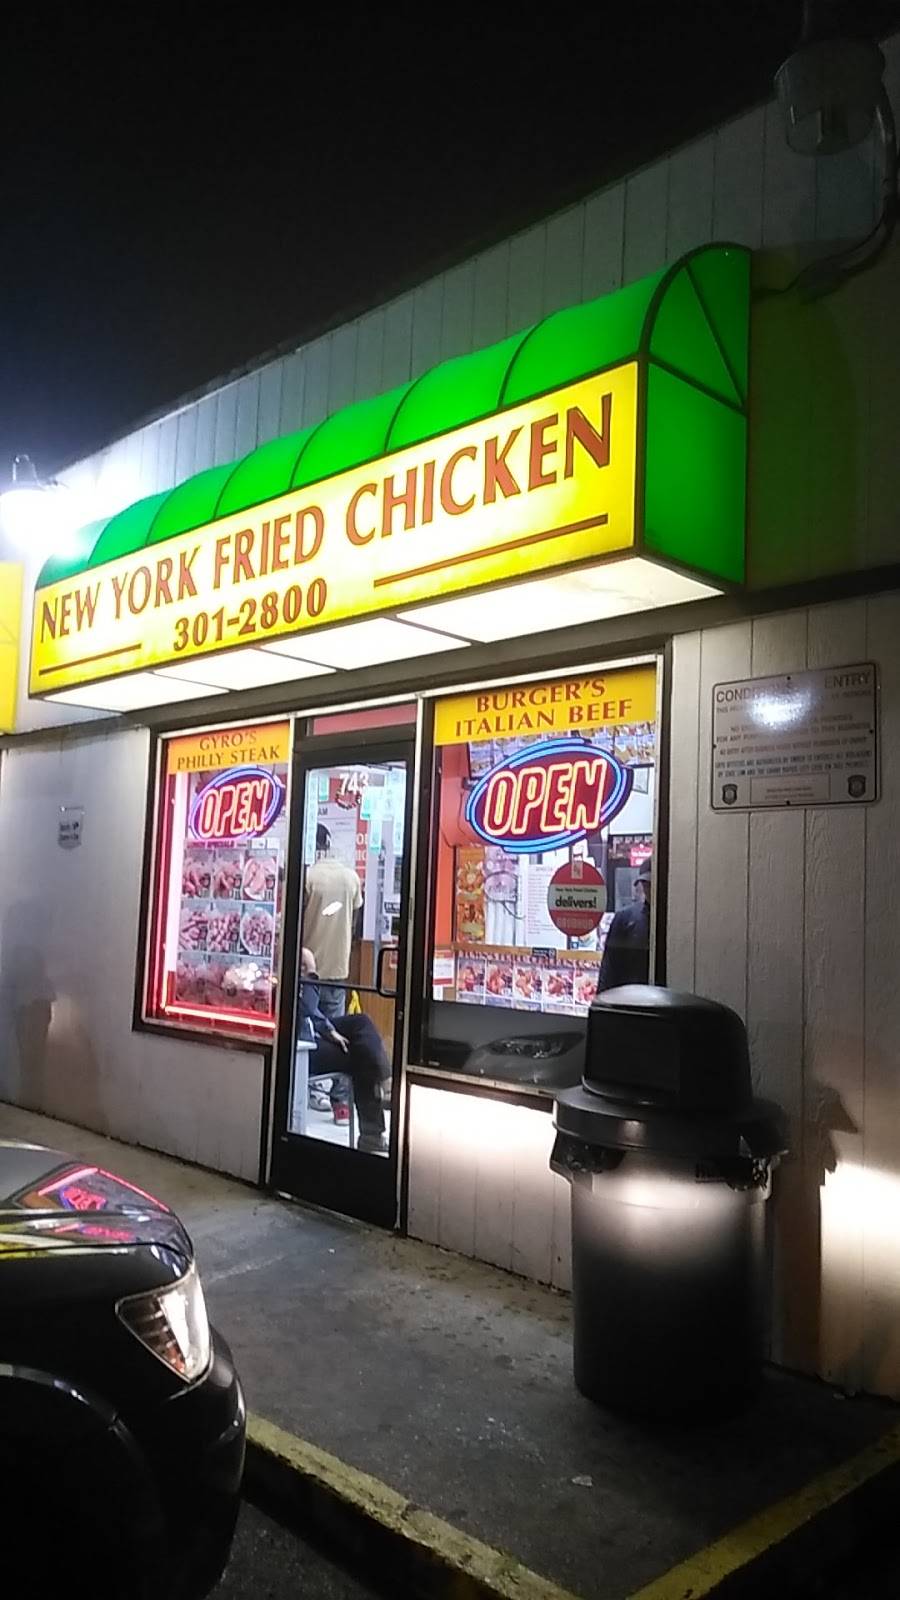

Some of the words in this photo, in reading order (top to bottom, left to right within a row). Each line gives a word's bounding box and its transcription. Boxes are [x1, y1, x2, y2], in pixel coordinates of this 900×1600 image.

[41, 581, 100, 644] NEW
[111, 545, 199, 621] YORK
[212, 505, 325, 590] FRIED
[345, 391, 612, 547] CHICKEN
[172, 577, 328, 653] 301-2800
[476, 678, 606, 714] BURGER'S
[824, 672, 872, 689] ENTRY
[455, 708, 555, 737] ITALIAN
[568, 698, 633, 724] BEEF
[177, 753, 226, 770] PHILLY
[230, 744, 280, 763] STEAK
[199, 729, 257, 751] GYRO'S
[338, 772, 370, 797] 743
[483, 757, 608, 836] OPEN
[198, 778, 270, 838] OPEN
[555, 895, 598, 909] delivers!
